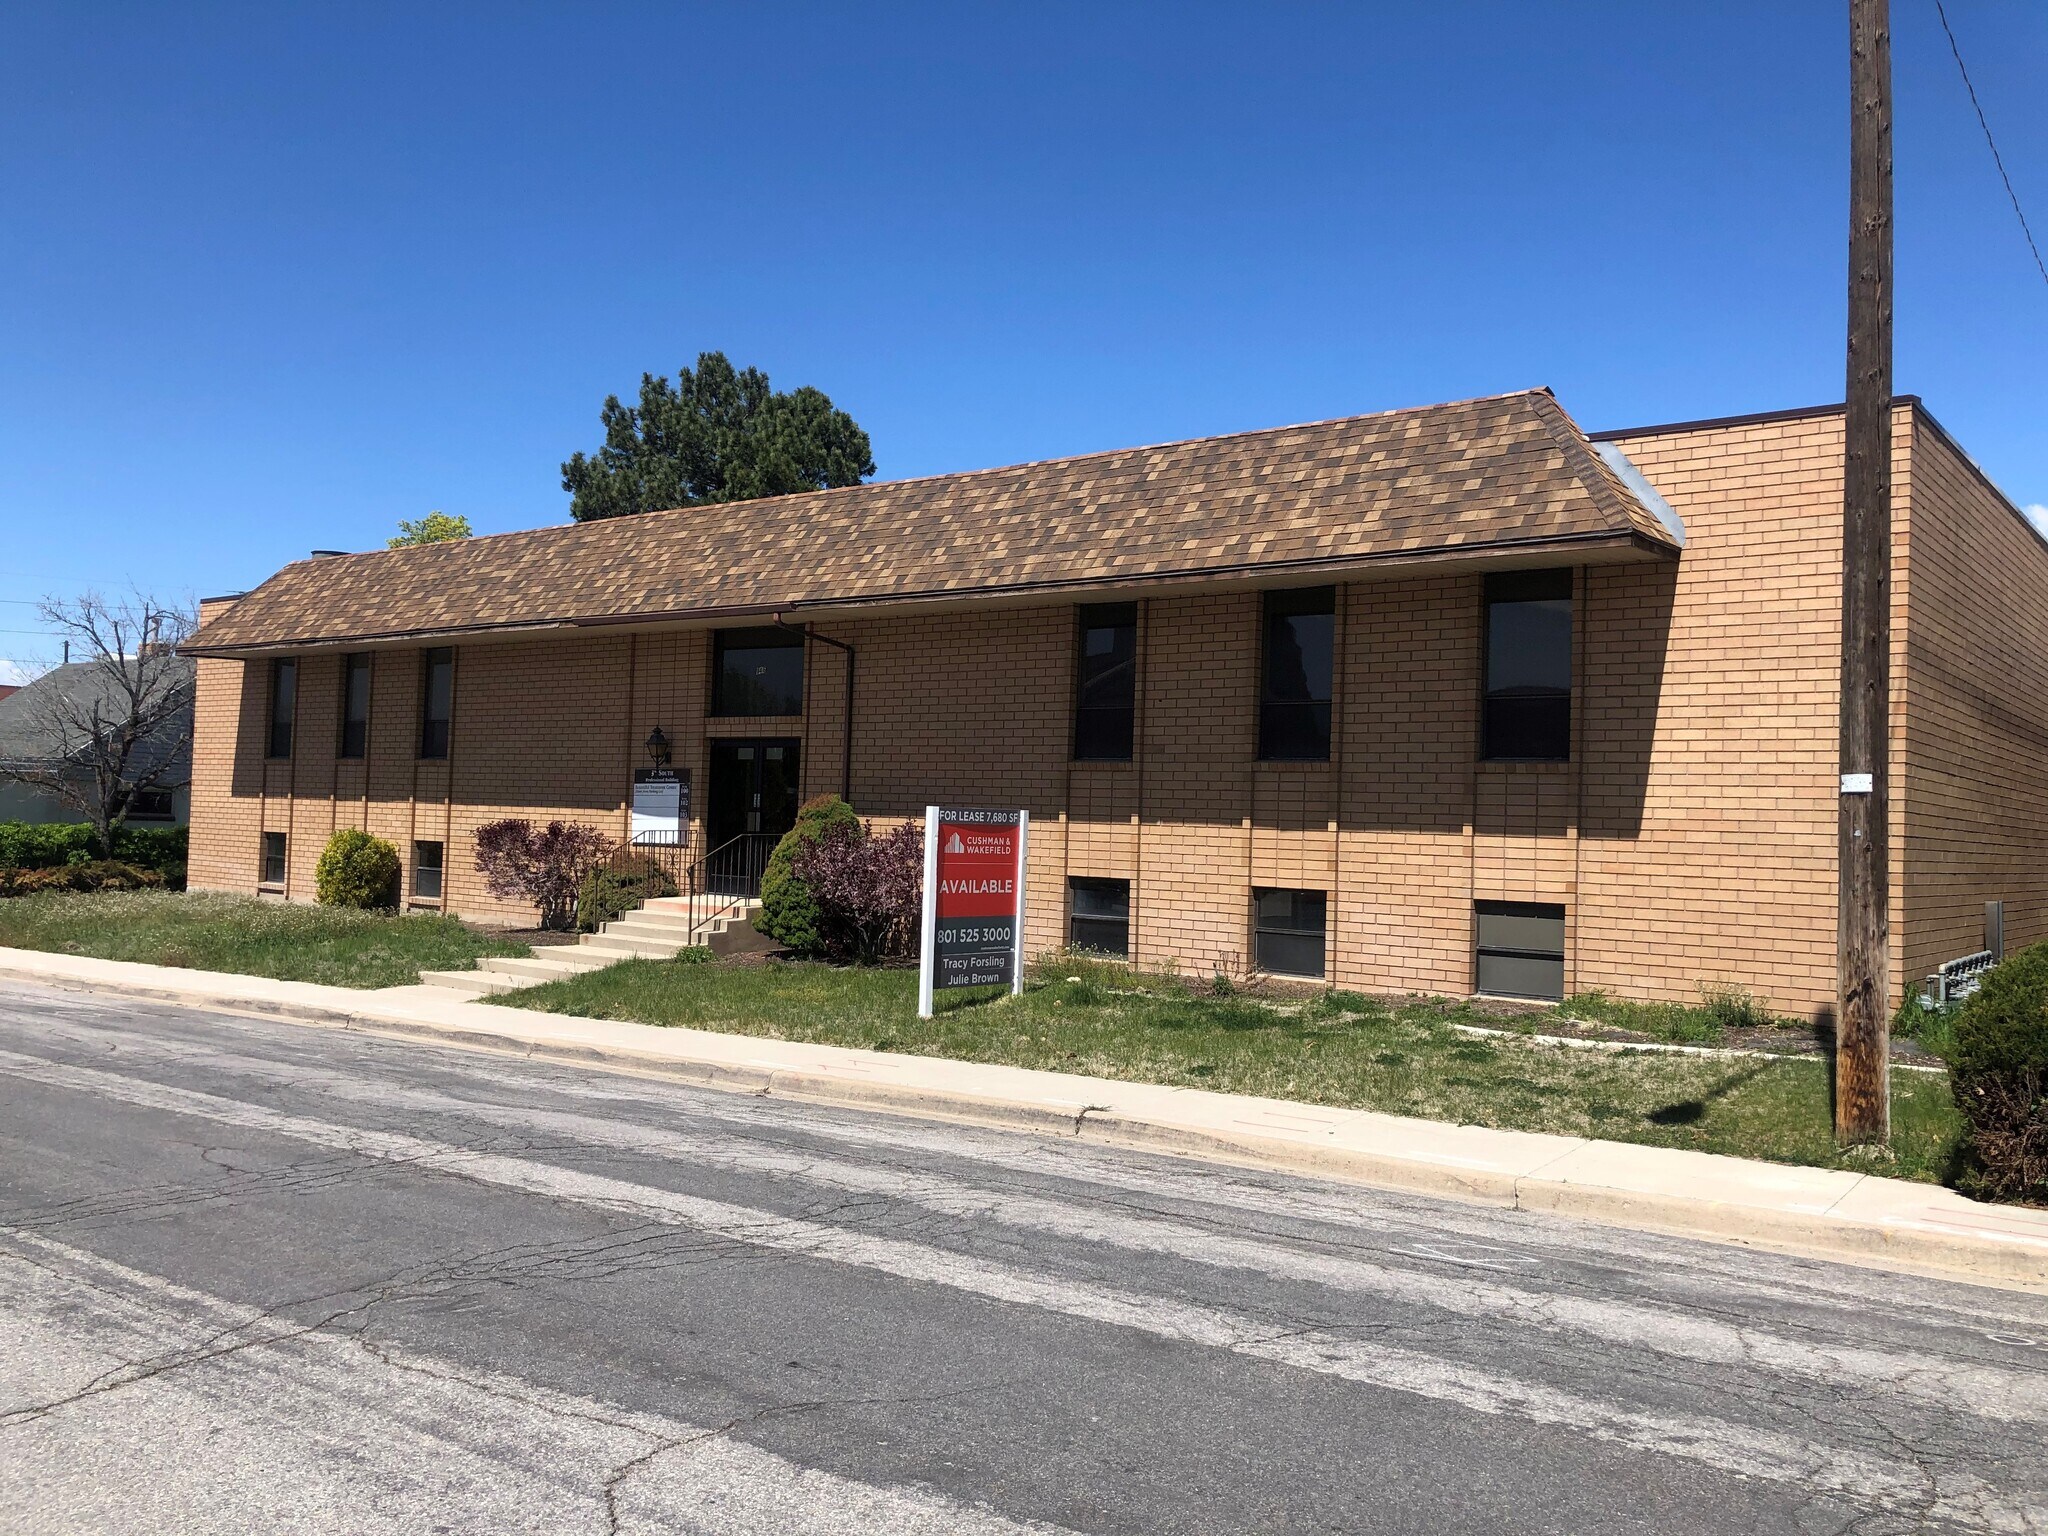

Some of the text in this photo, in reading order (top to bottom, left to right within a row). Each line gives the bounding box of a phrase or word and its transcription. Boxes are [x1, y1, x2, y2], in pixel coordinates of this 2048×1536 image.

[940, 810, 1019, 824] FOR LEASE 7,680 SF
[966, 836, 1011, 845] CUSHMAN &
[966, 846, 1011, 854] WAKEFIELD
[940, 879, 1013, 894] AVAILABLE
[937, 927, 1011, 943] 801 525 3000
[943, 956, 1005, 970] Tracy Forsling
[948, 973, 999, 985] Julie Brown
